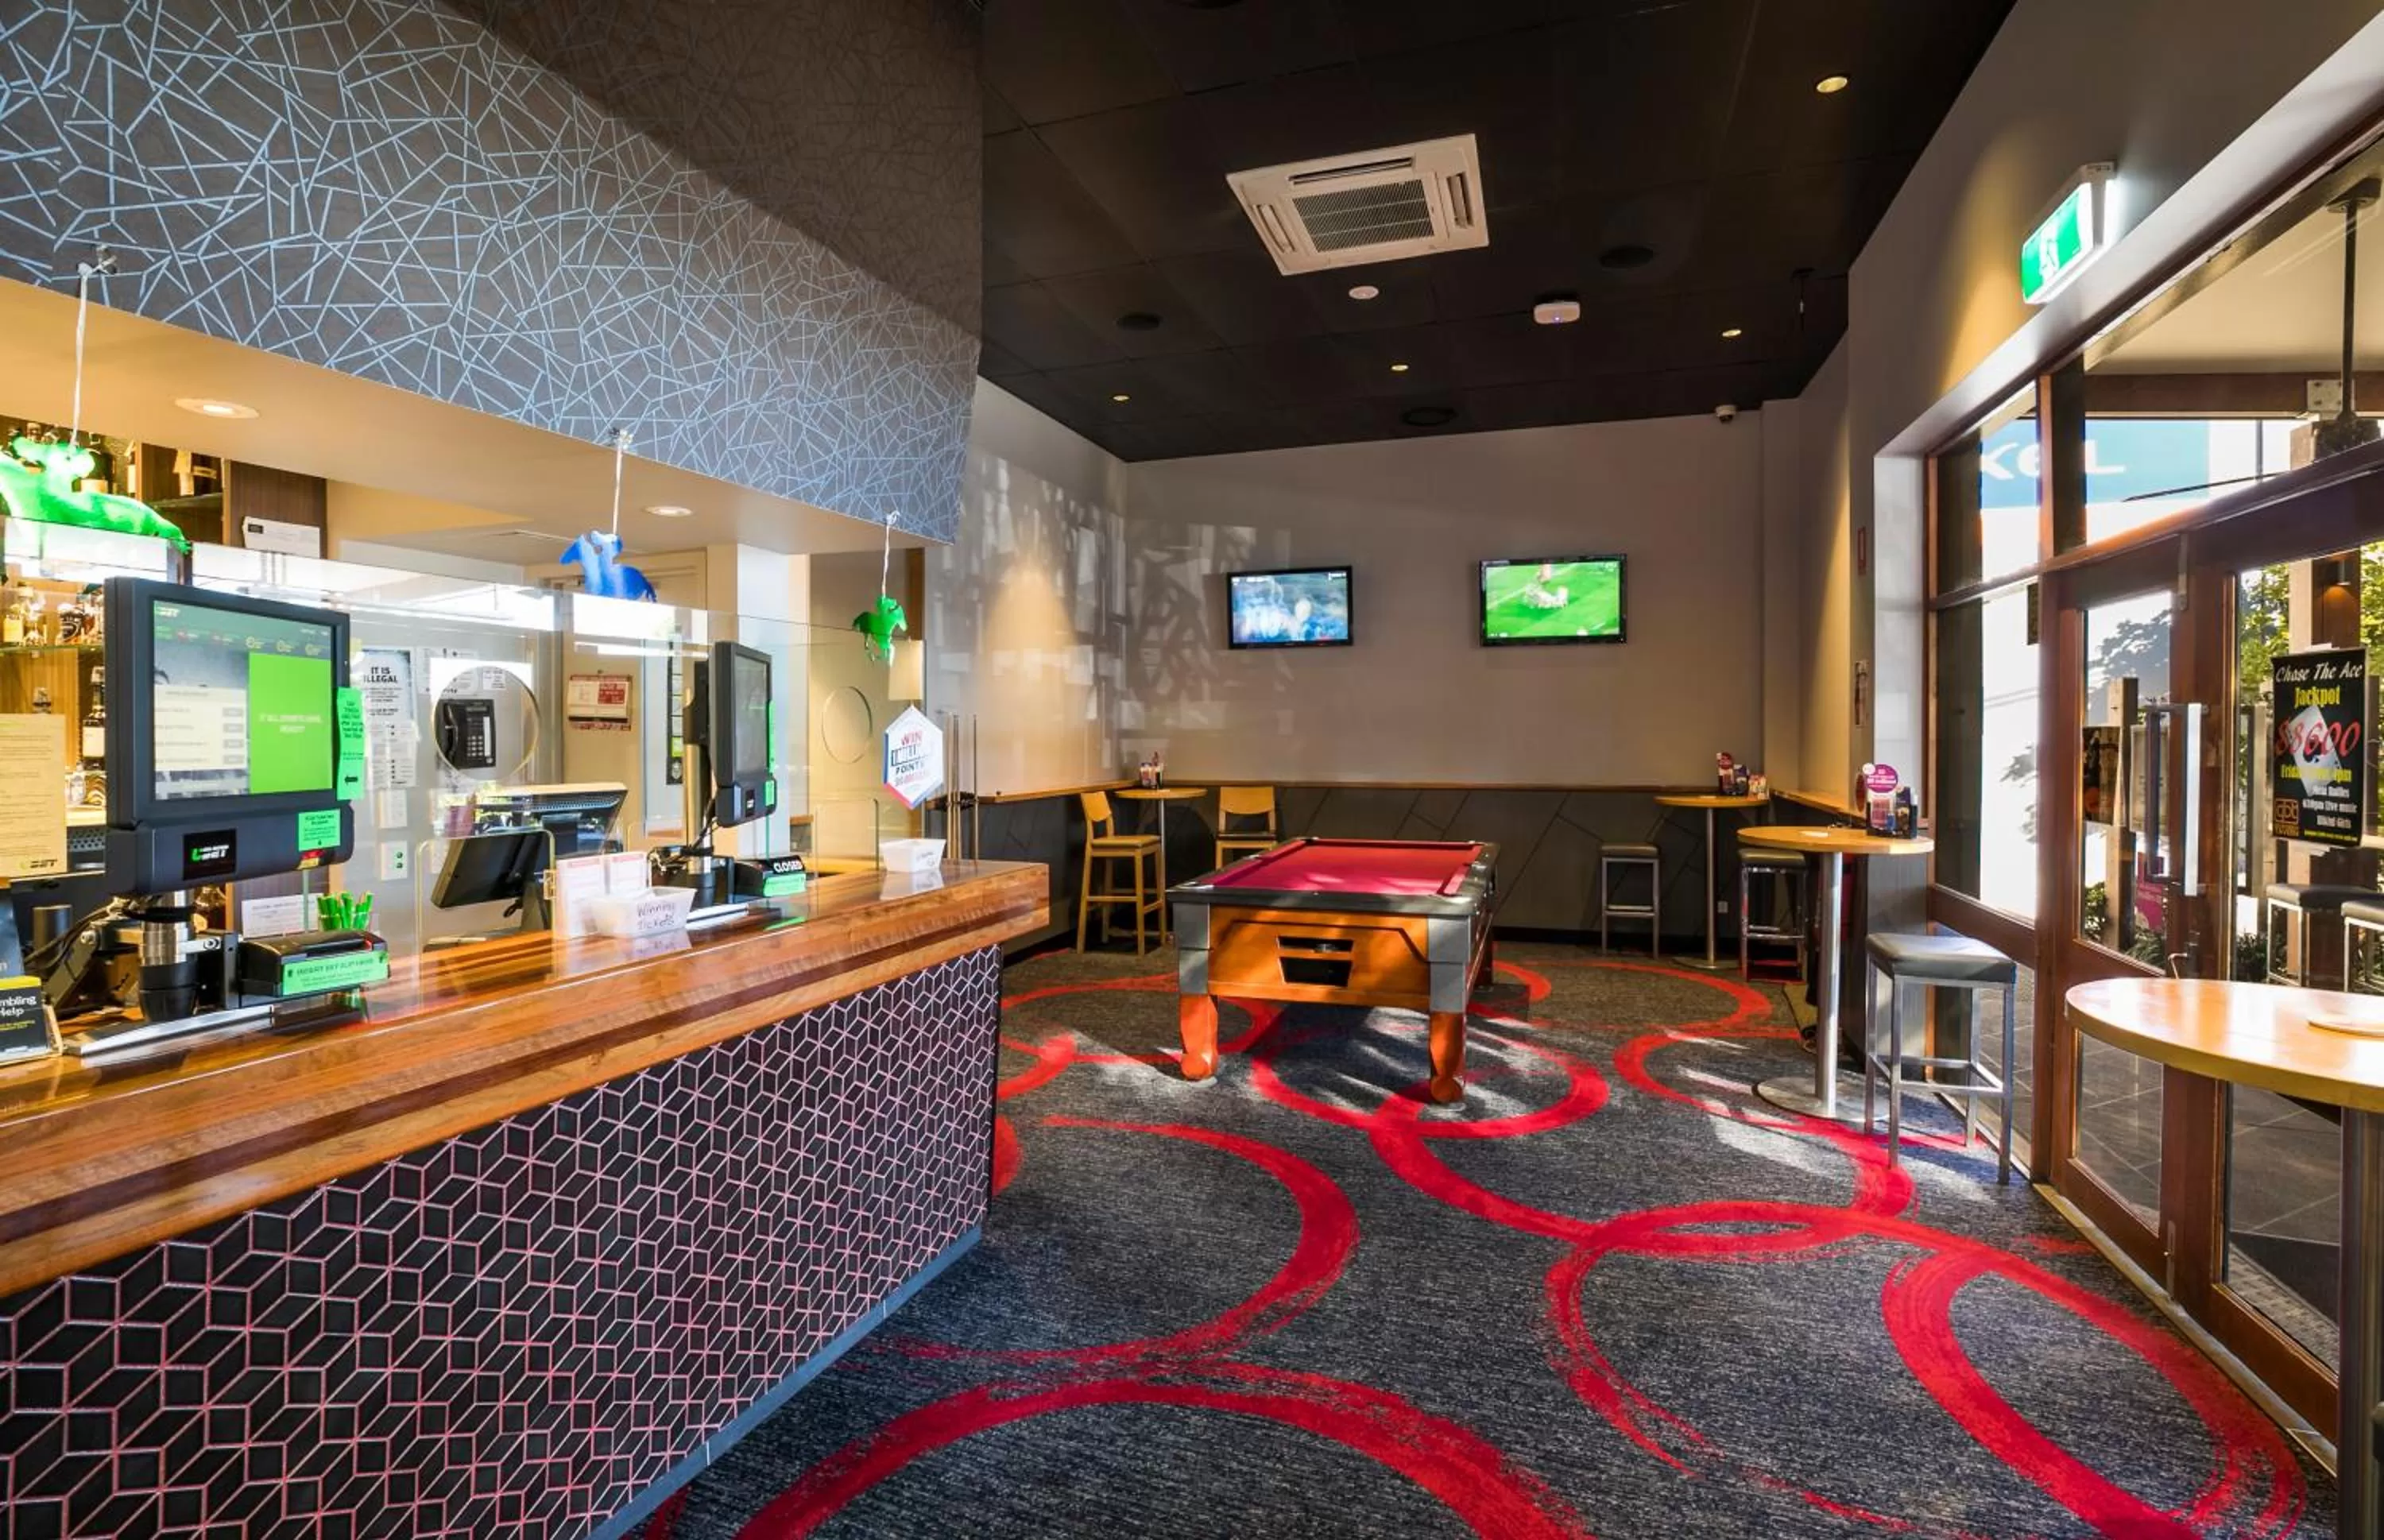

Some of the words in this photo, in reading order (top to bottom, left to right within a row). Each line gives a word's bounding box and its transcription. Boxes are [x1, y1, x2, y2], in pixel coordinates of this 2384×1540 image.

[363, 675, 398, 683] ILLEGAL
[2275, 665, 2310, 683] Chase
[2314, 661, 2337, 680] The
[2339, 660, 2363, 679] Ace
[2293, 685, 2341, 710] Jackpot
[900, 730, 922, 746] WIN
[773, 860, 803, 873] CLOSED
